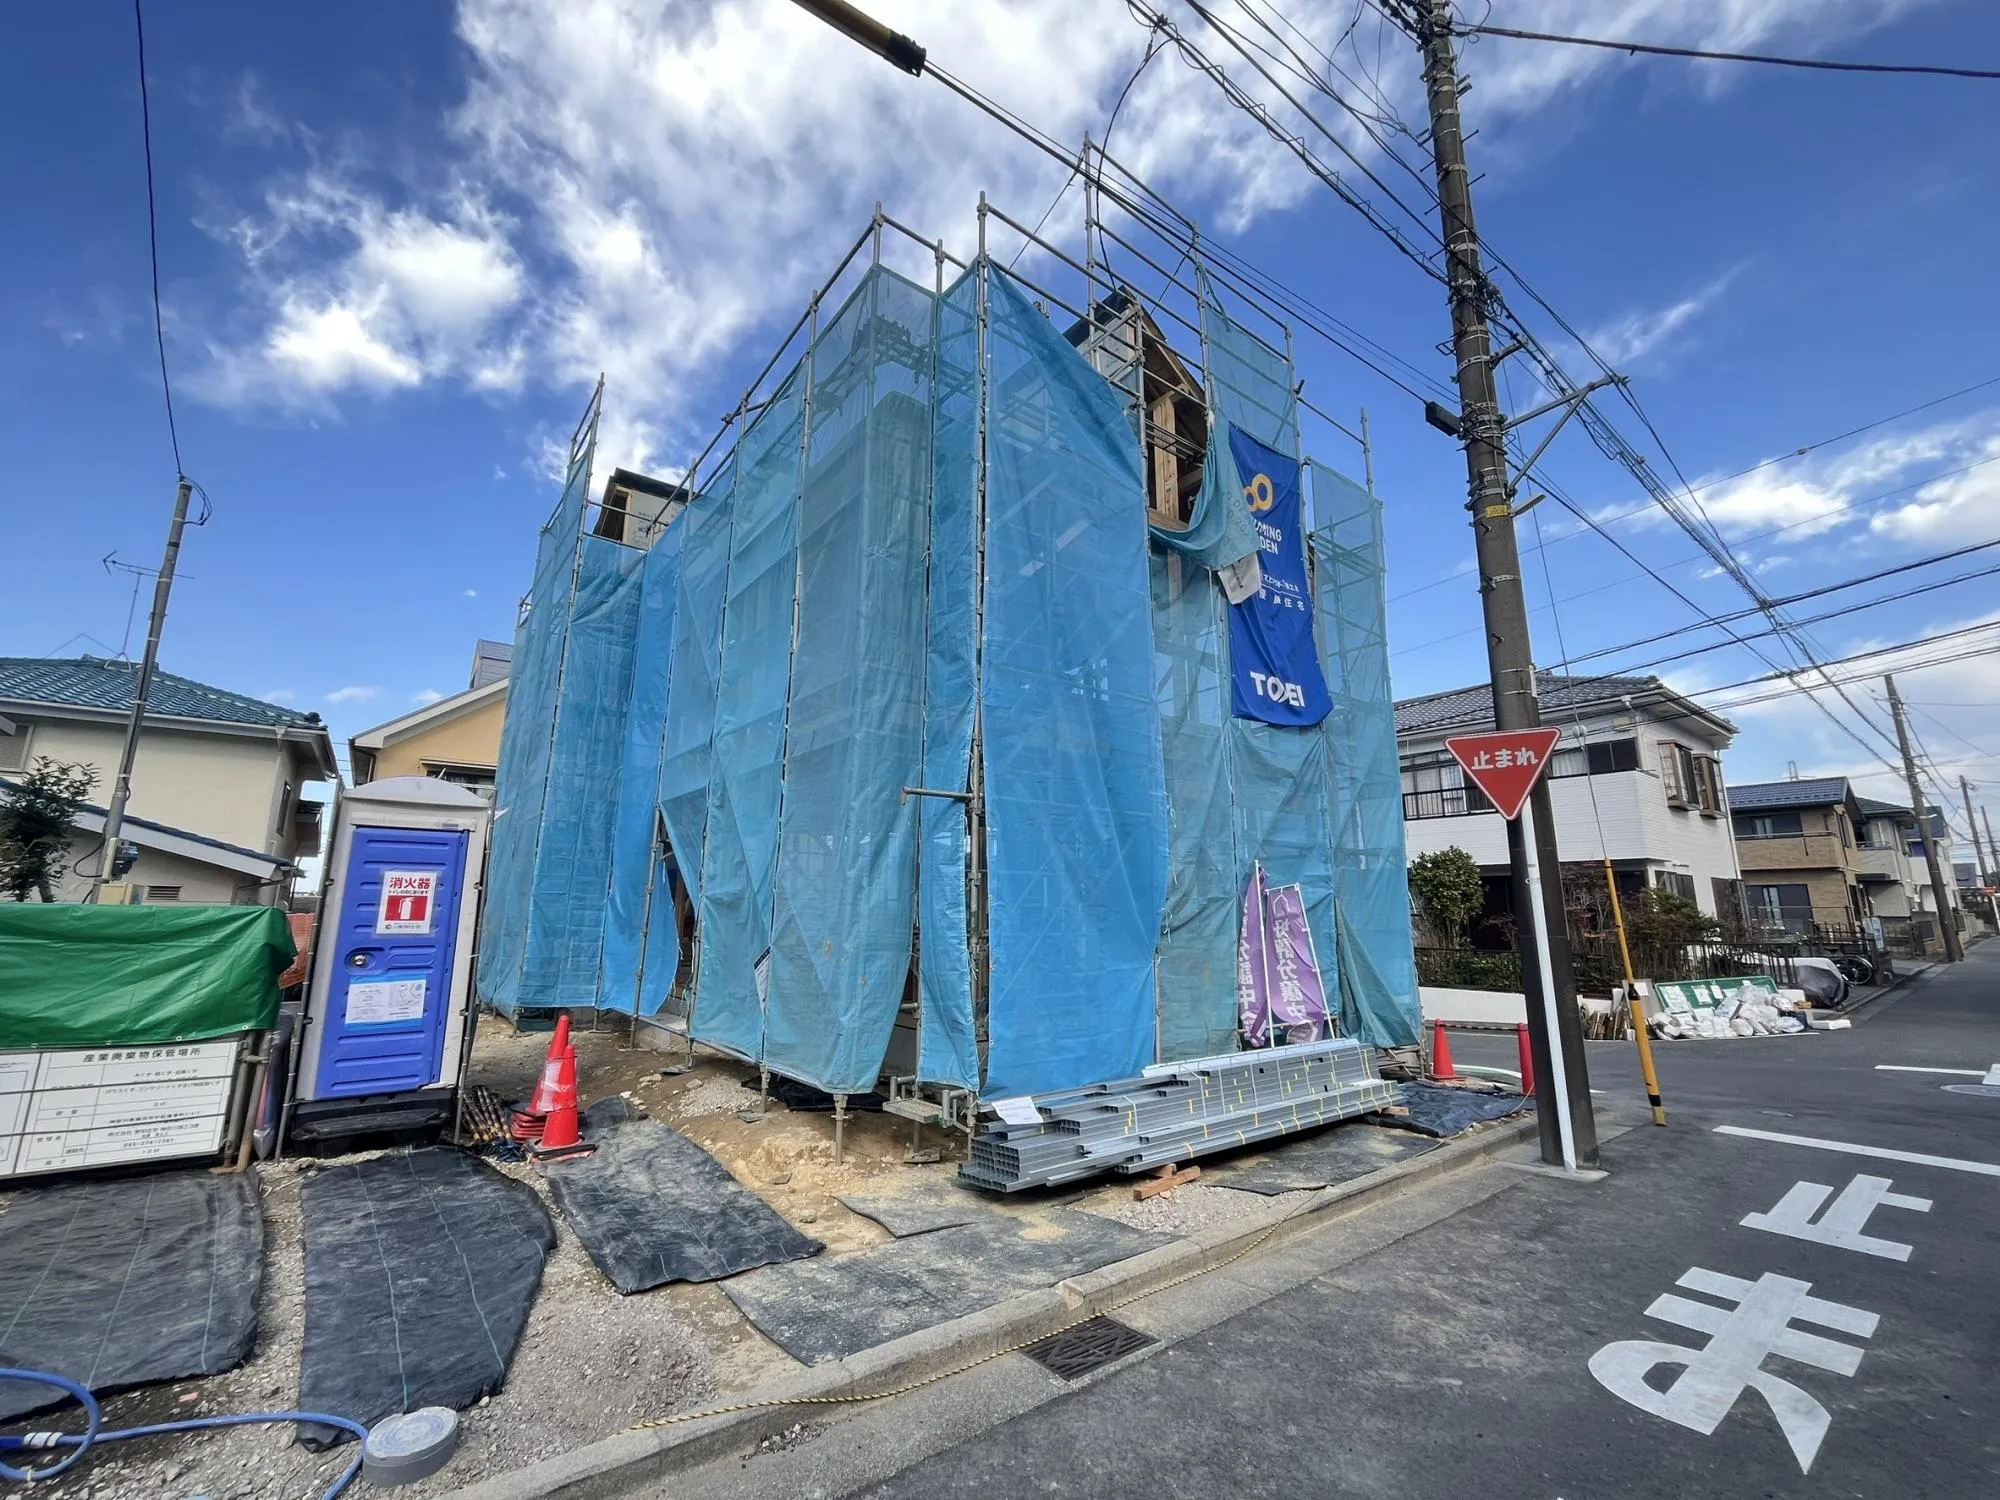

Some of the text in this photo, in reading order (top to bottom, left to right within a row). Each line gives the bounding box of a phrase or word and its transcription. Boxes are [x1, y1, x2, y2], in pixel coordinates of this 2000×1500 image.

[1258, 535, 1278, 555] DEN
[1249, 670, 1305, 707] TOEI
[1471, 747, 1539, 770] 止まれ
[389, 876, 431, 890] 消火器
[82, 1048, 201, 1063] 産業廃棄物保管場所
